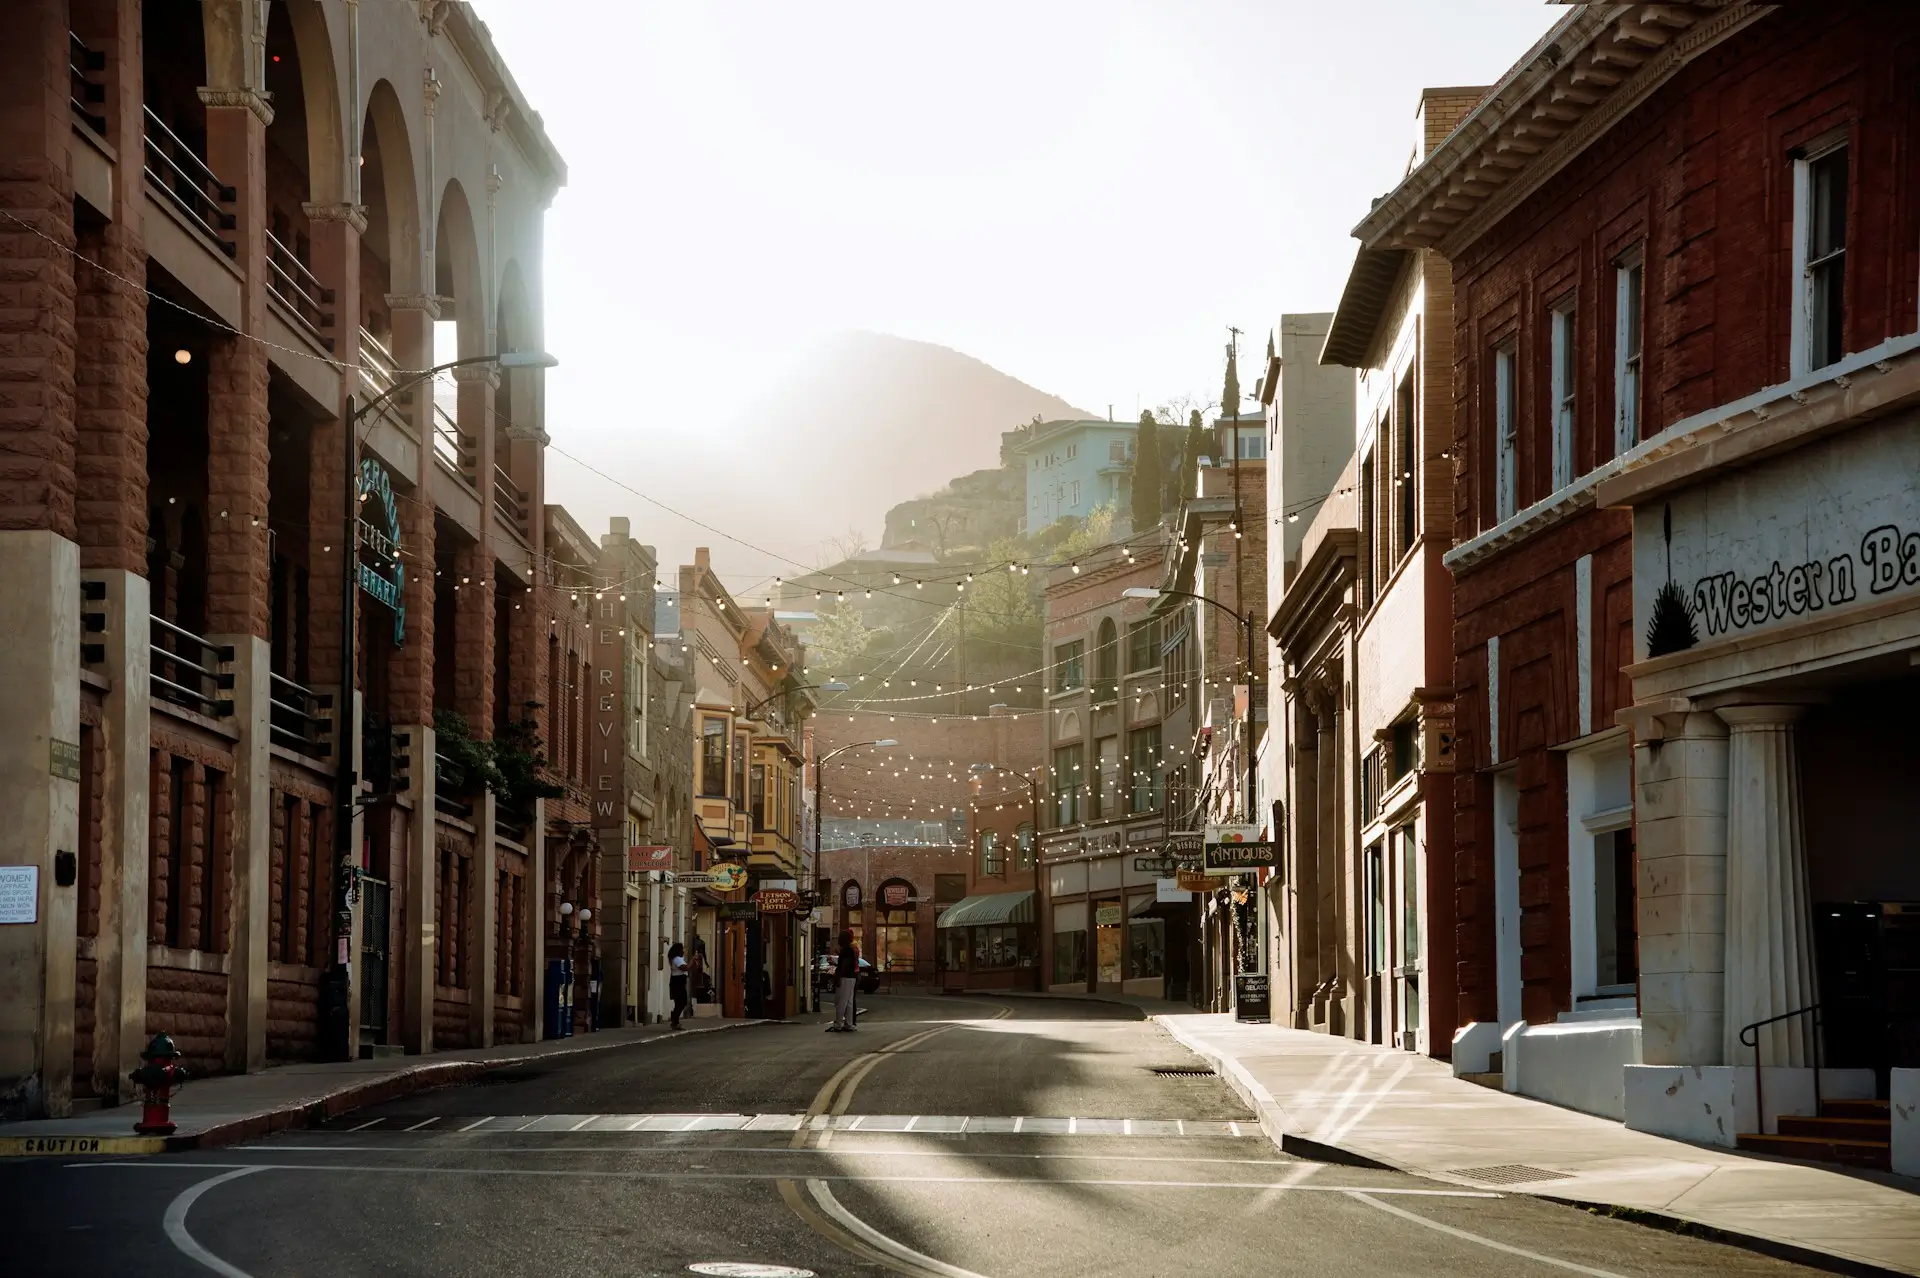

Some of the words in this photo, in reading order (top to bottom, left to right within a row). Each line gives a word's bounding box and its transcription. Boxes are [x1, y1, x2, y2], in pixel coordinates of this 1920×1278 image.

[1693, 552, 1856, 637] Western
[599, 576, 614, 645] THE
[52, 741, 63, 757] POST
[64, 744, 80, 763] OFFICE
[596, 669, 614, 818] REVIEW
[1211, 846, 1273, 865] ANTIQUES
[760, 891, 791, 900] LETSON
[762, 903, 789, 911] HOTEL
[26, 1139, 99, 1152] CAUTION
